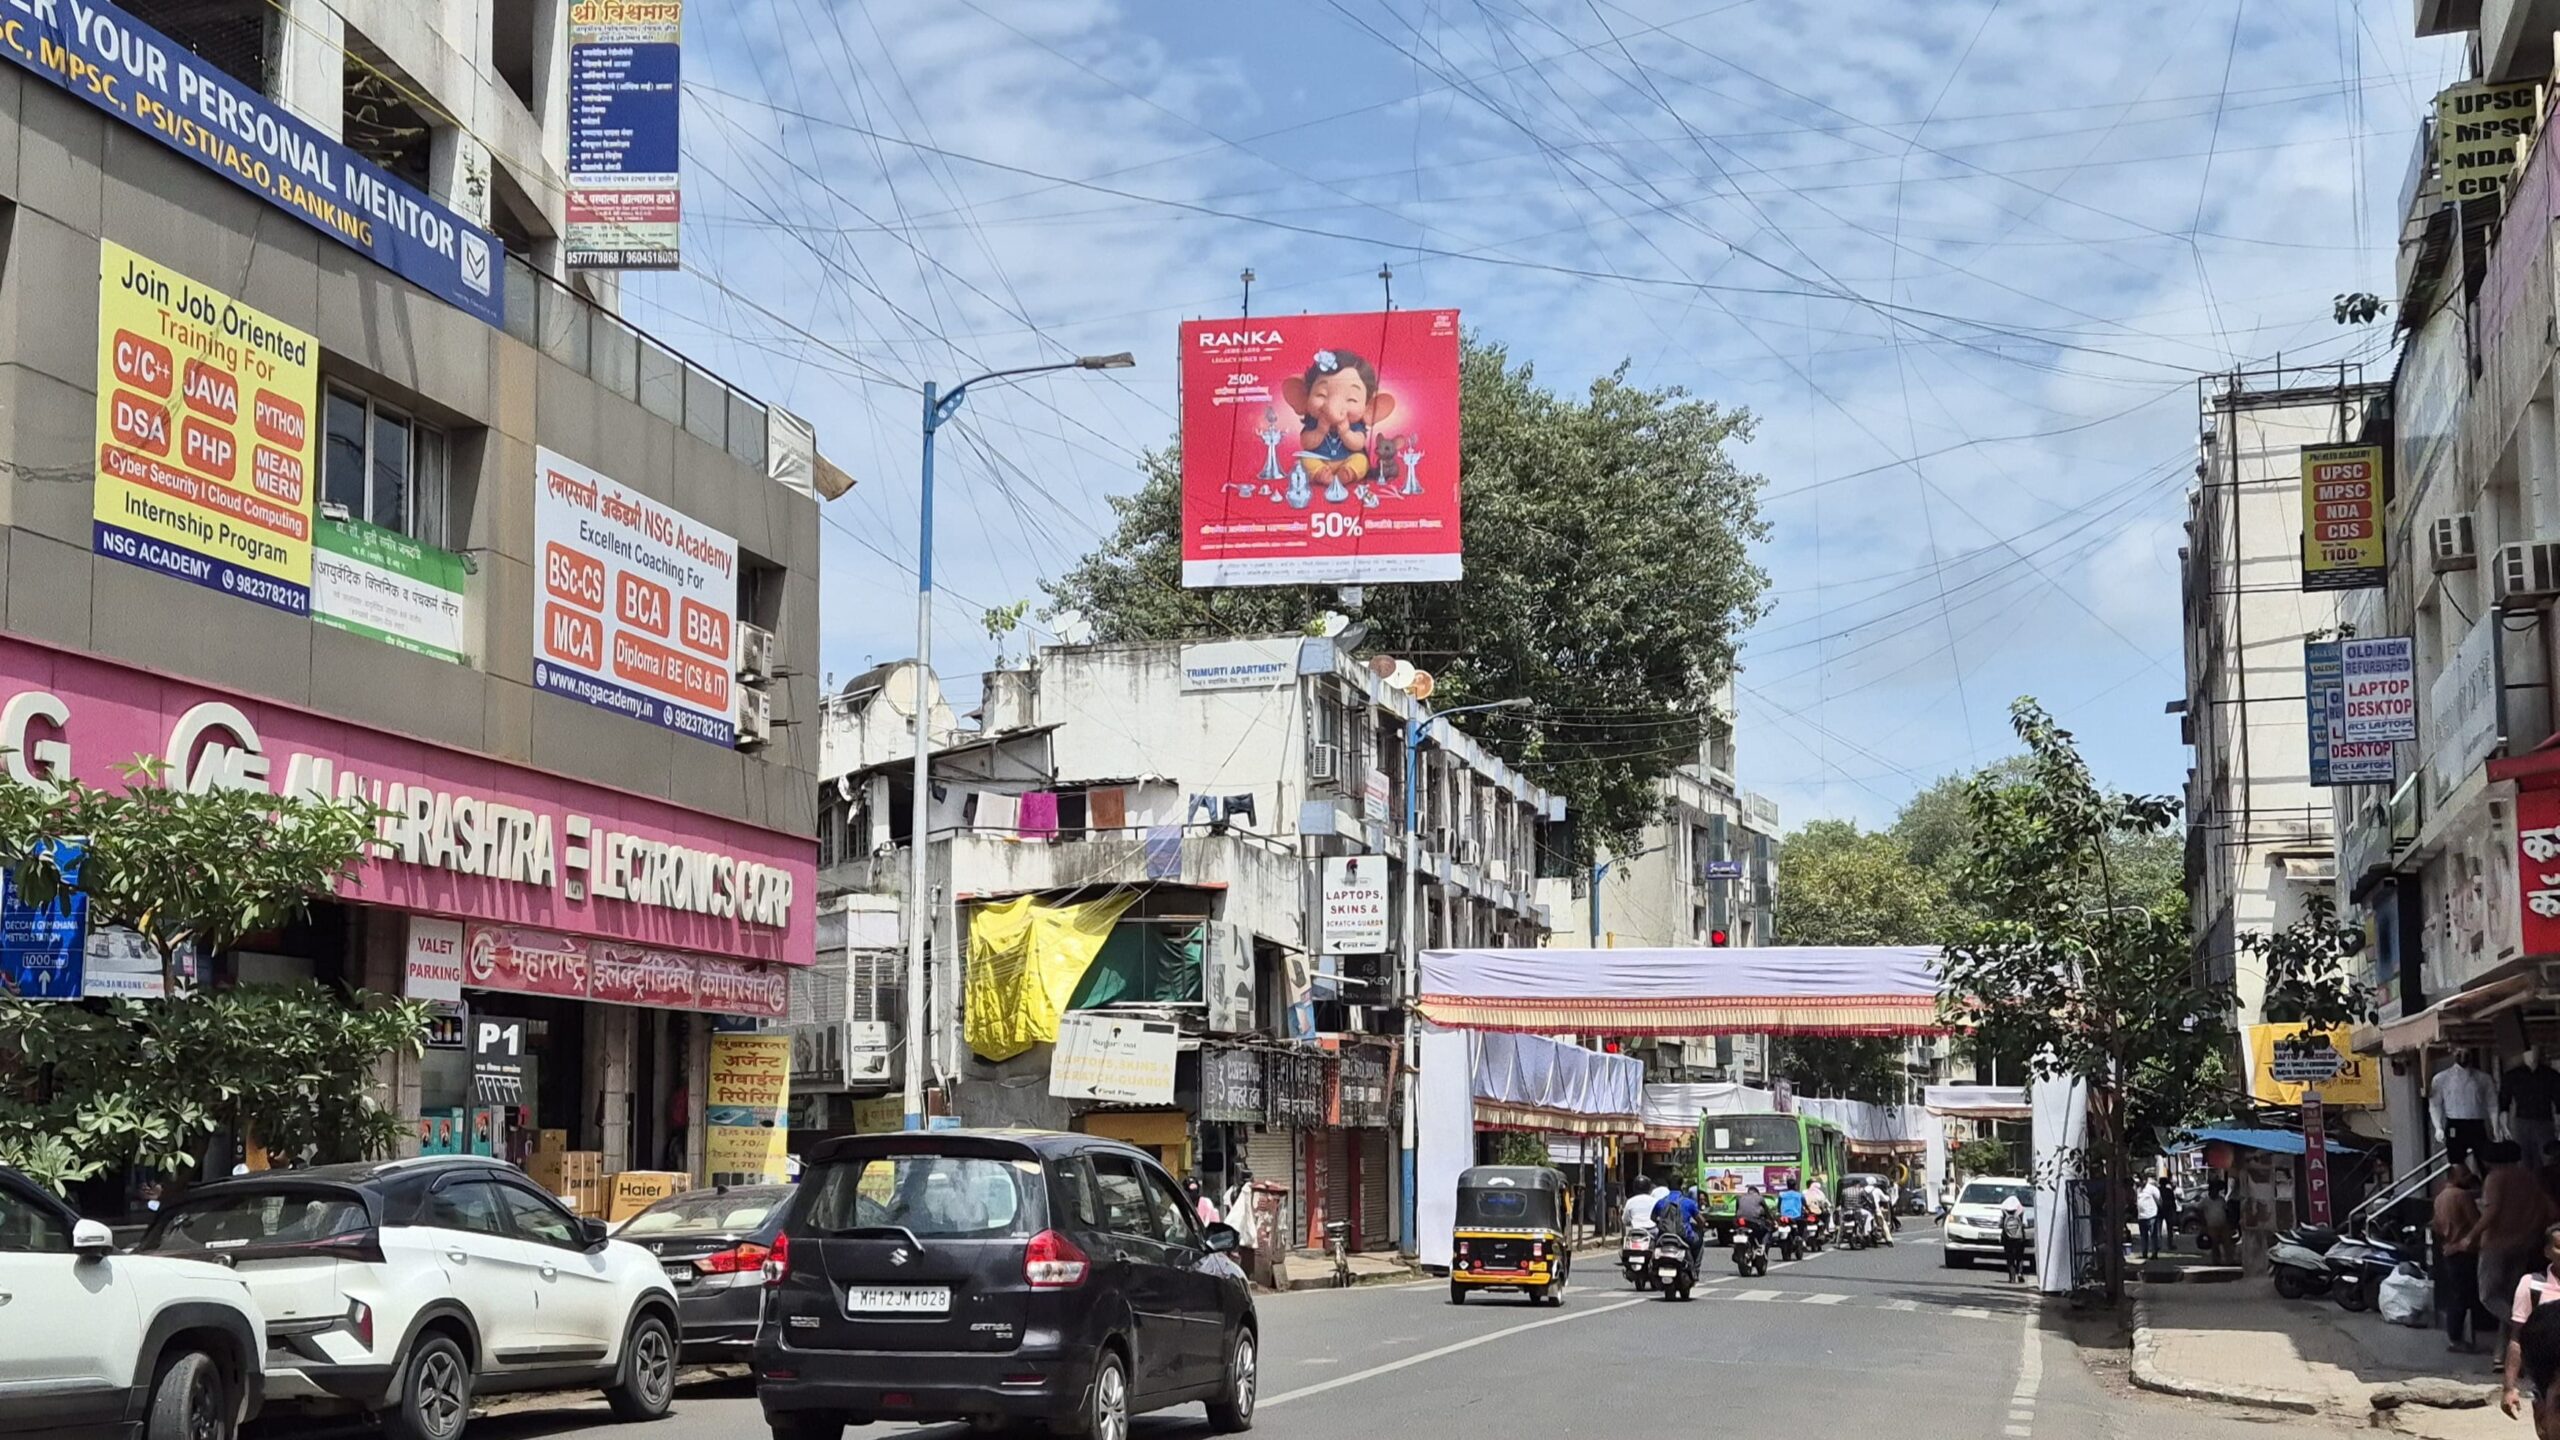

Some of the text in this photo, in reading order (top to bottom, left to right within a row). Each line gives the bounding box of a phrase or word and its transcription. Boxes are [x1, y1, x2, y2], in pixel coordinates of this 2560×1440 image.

[40, 37, 127, 113] MPSC,
[2455, 89, 2533, 115] UPSC
[70, 0, 168, 93] YOUR
[178, 62, 337, 192] PERSONAL
[345, 164, 454, 261] MENTOR
[2457, 147, 2517, 169] NDA
[121, 260, 306, 367] Join Job Oriented
[157, 308, 275, 381] Training For
[1199, 330, 1284, 347] RANKA
[117, 341, 171, 382] C/C++
[183, 368, 238, 415] JAVA
[117, 401, 166, 445] DSA
[256, 400, 304, 440] PYTHON
[187, 428, 232, 467] PHP
[256, 448, 301, 481] MEAN
[2320, 463, 2364, 481] UPSC
[109, 450, 148, 478] Cyber
[151, 463, 199, 500] Security
[207, 484, 242, 512] Cloud
[243, 498, 304, 537] Computing
[255, 469, 300, 502] MERN
[2319, 483, 2366, 500] MPSC
[1310, 512, 1363, 538] 50%
[2326, 503, 2360, 519] NDA
[125, 491, 288, 565] Internship Program
[645, 507, 673, 546] NSG
[676, 524, 732, 580] Academy
[2327, 523, 2360, 539] CDS
[103, 531, 305, 610] NSG ACADEMY 9823782121
[579, 519, 704, 590] Excellent Coaching For
[549, 550, 602, 604] BSc-CS
[625, 579, 662, 629] BCA
[553, 612, 594, 662] MCA
[687, 607, 723, 651] BBA
[616, 638, 659, 676] Diploma
[668, 658, 682, 684] BE
[684, 663, 703, 692] (CS
[704, 673, 712, 693] &
[1186, 667, 1228, 678] TRIMURTI
[2348, 679, 2410, 697] LAPTOP
[549, 669, 729, 742] www.nsgacademy.in 9823782121
[2347, 698, 2412, 718] DESKTOP
[2368, 720, 2414, 730] LAPTOPS
[2331, 741, 2391, 759] DESKTOP
[2351, 761, 2393, 770] LAPTOPS
[564, 814, 736, 919] ELECTRONICS
[735, 860, 793, 928] CORP
[1326, 890, 1384, 900] LAPTOPS,
[1330, 904, 1379, 915] SKINS &
[25, 954, 51, 966] 1000
[416, 936, 454, 956] VALET
[409, 962, 461, 983] PARKING
[478, 1022, 519, 1056] P1
[619, 1182, 662, 1197] Haier
